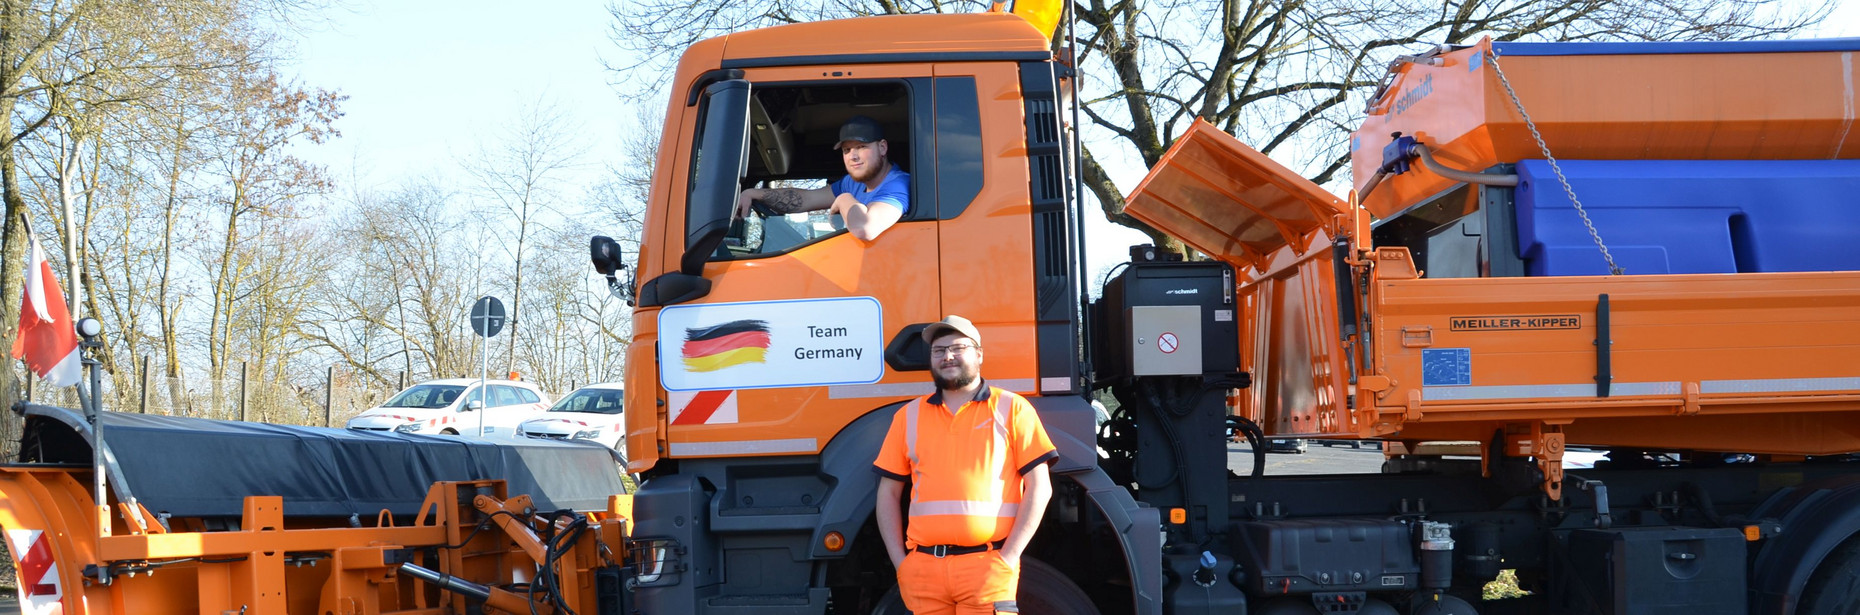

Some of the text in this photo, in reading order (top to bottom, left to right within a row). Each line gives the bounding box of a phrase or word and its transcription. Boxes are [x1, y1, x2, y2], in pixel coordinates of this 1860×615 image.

[1396, 74, 1433, 115] schmidt
[1453, 318, 1578, 329] MEILLER-KIPPER
[807, 325, 847, 338] Team
[794, 346, 863, 361] Germany
